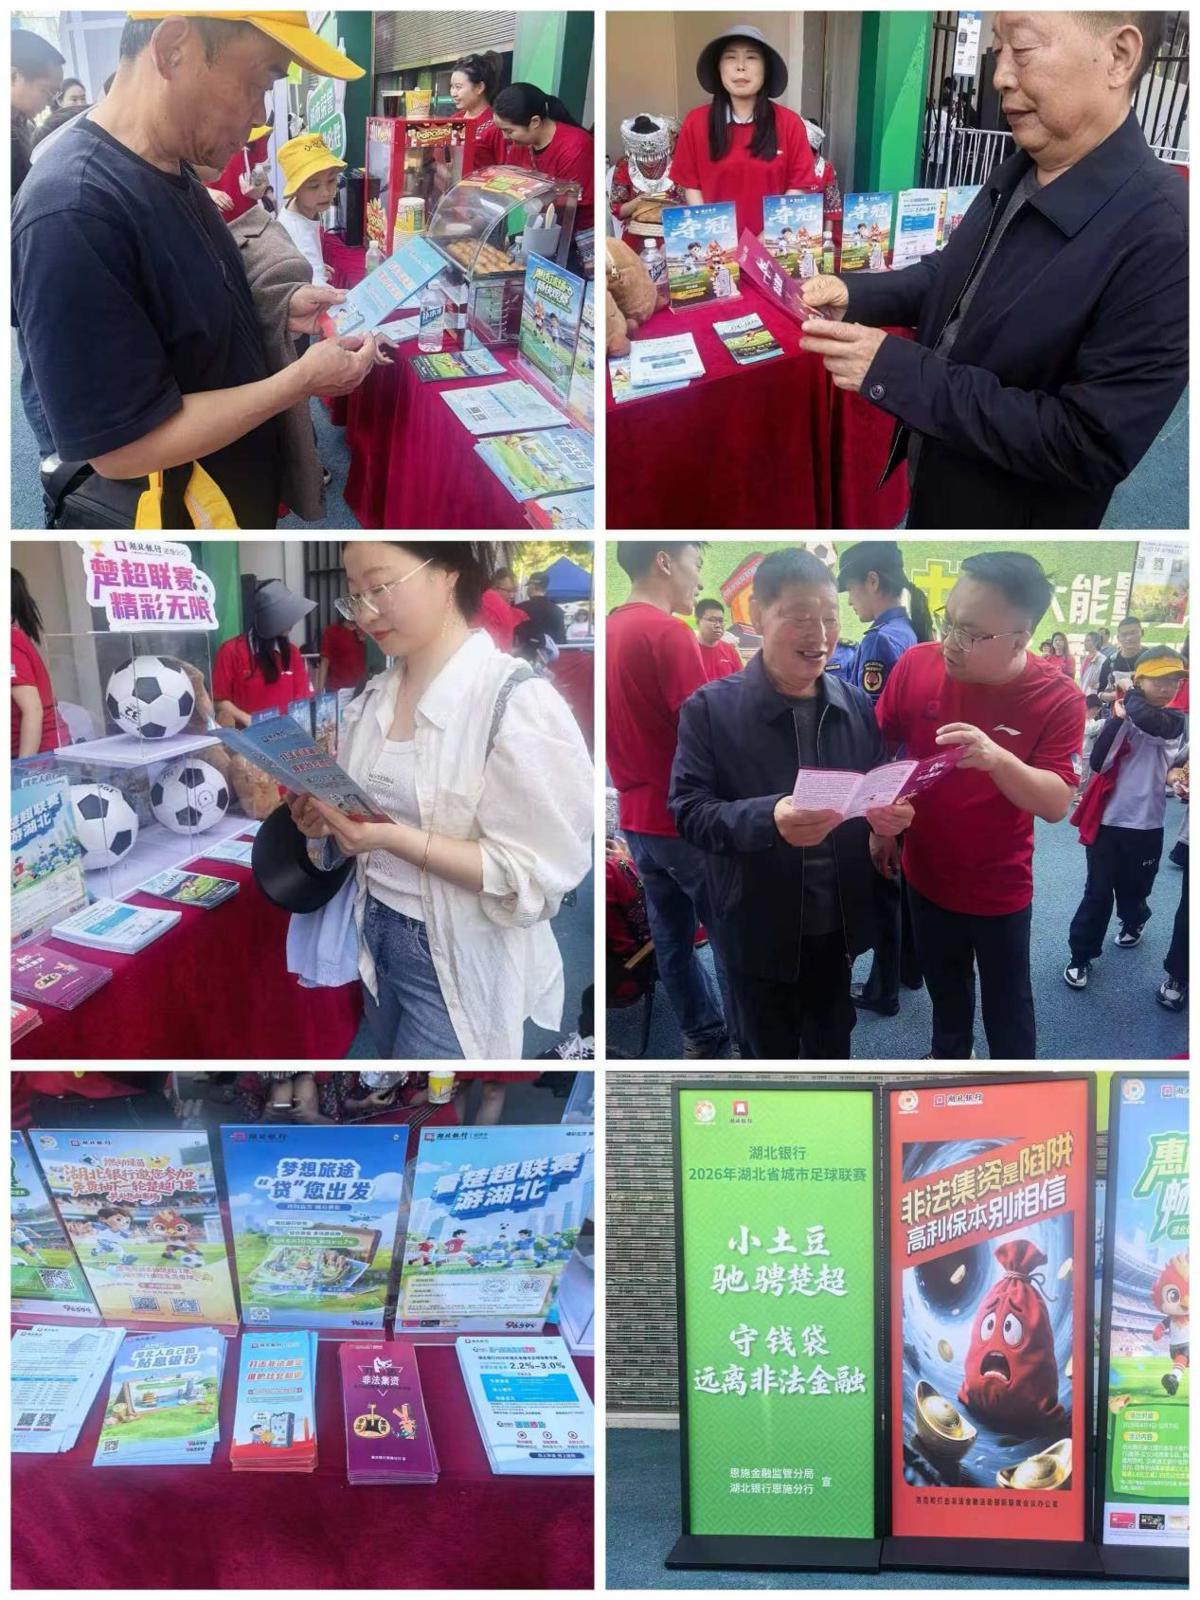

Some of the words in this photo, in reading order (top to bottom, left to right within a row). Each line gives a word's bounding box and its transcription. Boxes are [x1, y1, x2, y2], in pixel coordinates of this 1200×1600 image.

[670, 214, 730, 239] 夺冠
[90, 558, 193, 599] 楚超联赛
[110, 592, 213, 623] 精彩无限
[749, 1146, 806, 1160] 湖北银行
[280, 1160, 356, 1178] 梦想旅途
[689, 1167, 867, 1182] 2026年湖北省城市足球联赛
[901, 1130, 1074, 1224] 非法集资是陷阱
[453, 1179, 547, 1212] 游湖北
[907, 1174, 1067, 1254] 高利保本别相信
[728, 1224, 830, 1255] 小土豆
[710, 1262, 848, 1296] 驰骋楚超
[729, 1323, 830, 1357] 守钱袋
[362, 1375, 400, 1386] 非法集资
[694, 1364, 866, 1396] 远离非法金融
[730, 1467, 815, 1479] 恩施金融监管分局
[730, 1483, 815, 1494] 湖北银行恩施分行
